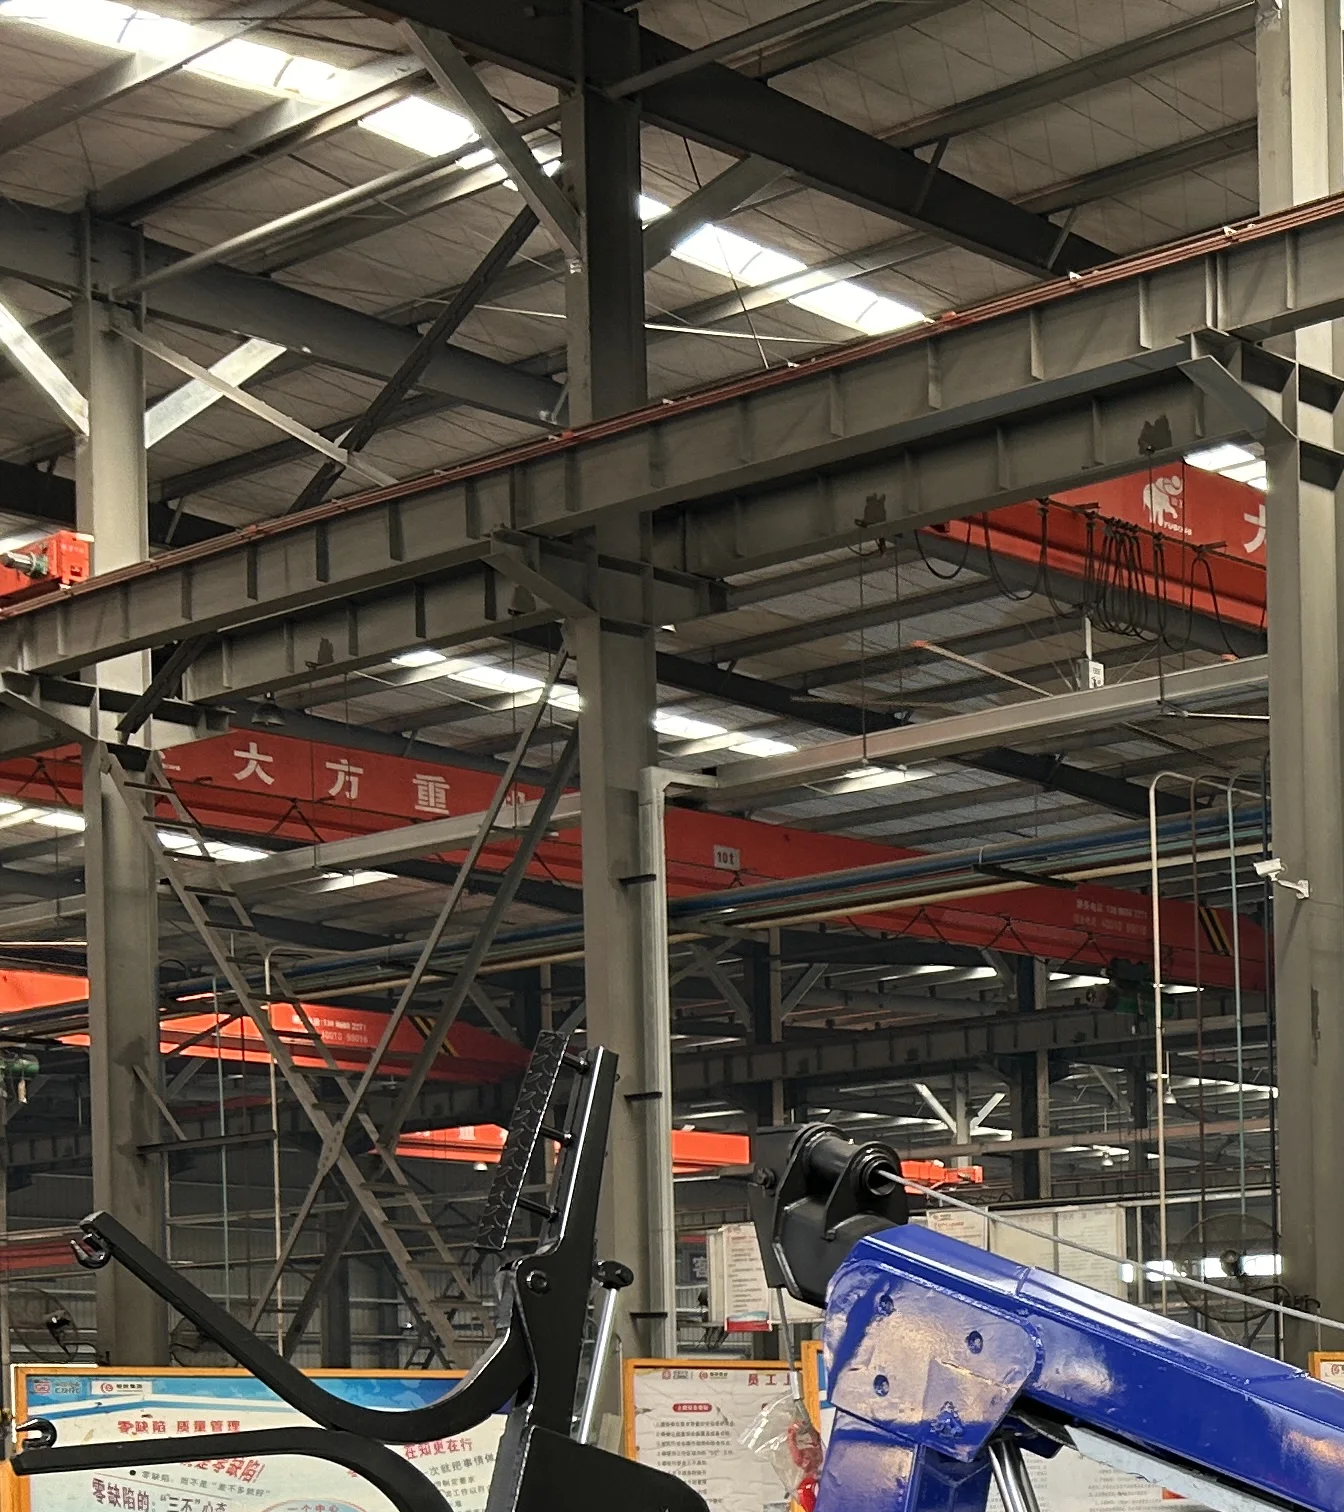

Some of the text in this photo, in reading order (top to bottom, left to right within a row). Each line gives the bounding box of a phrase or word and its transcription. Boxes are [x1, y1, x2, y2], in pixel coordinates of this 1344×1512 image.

[717, 851, 735, 865] 10t
[176, 1420, 241, 1434] 质量管理
